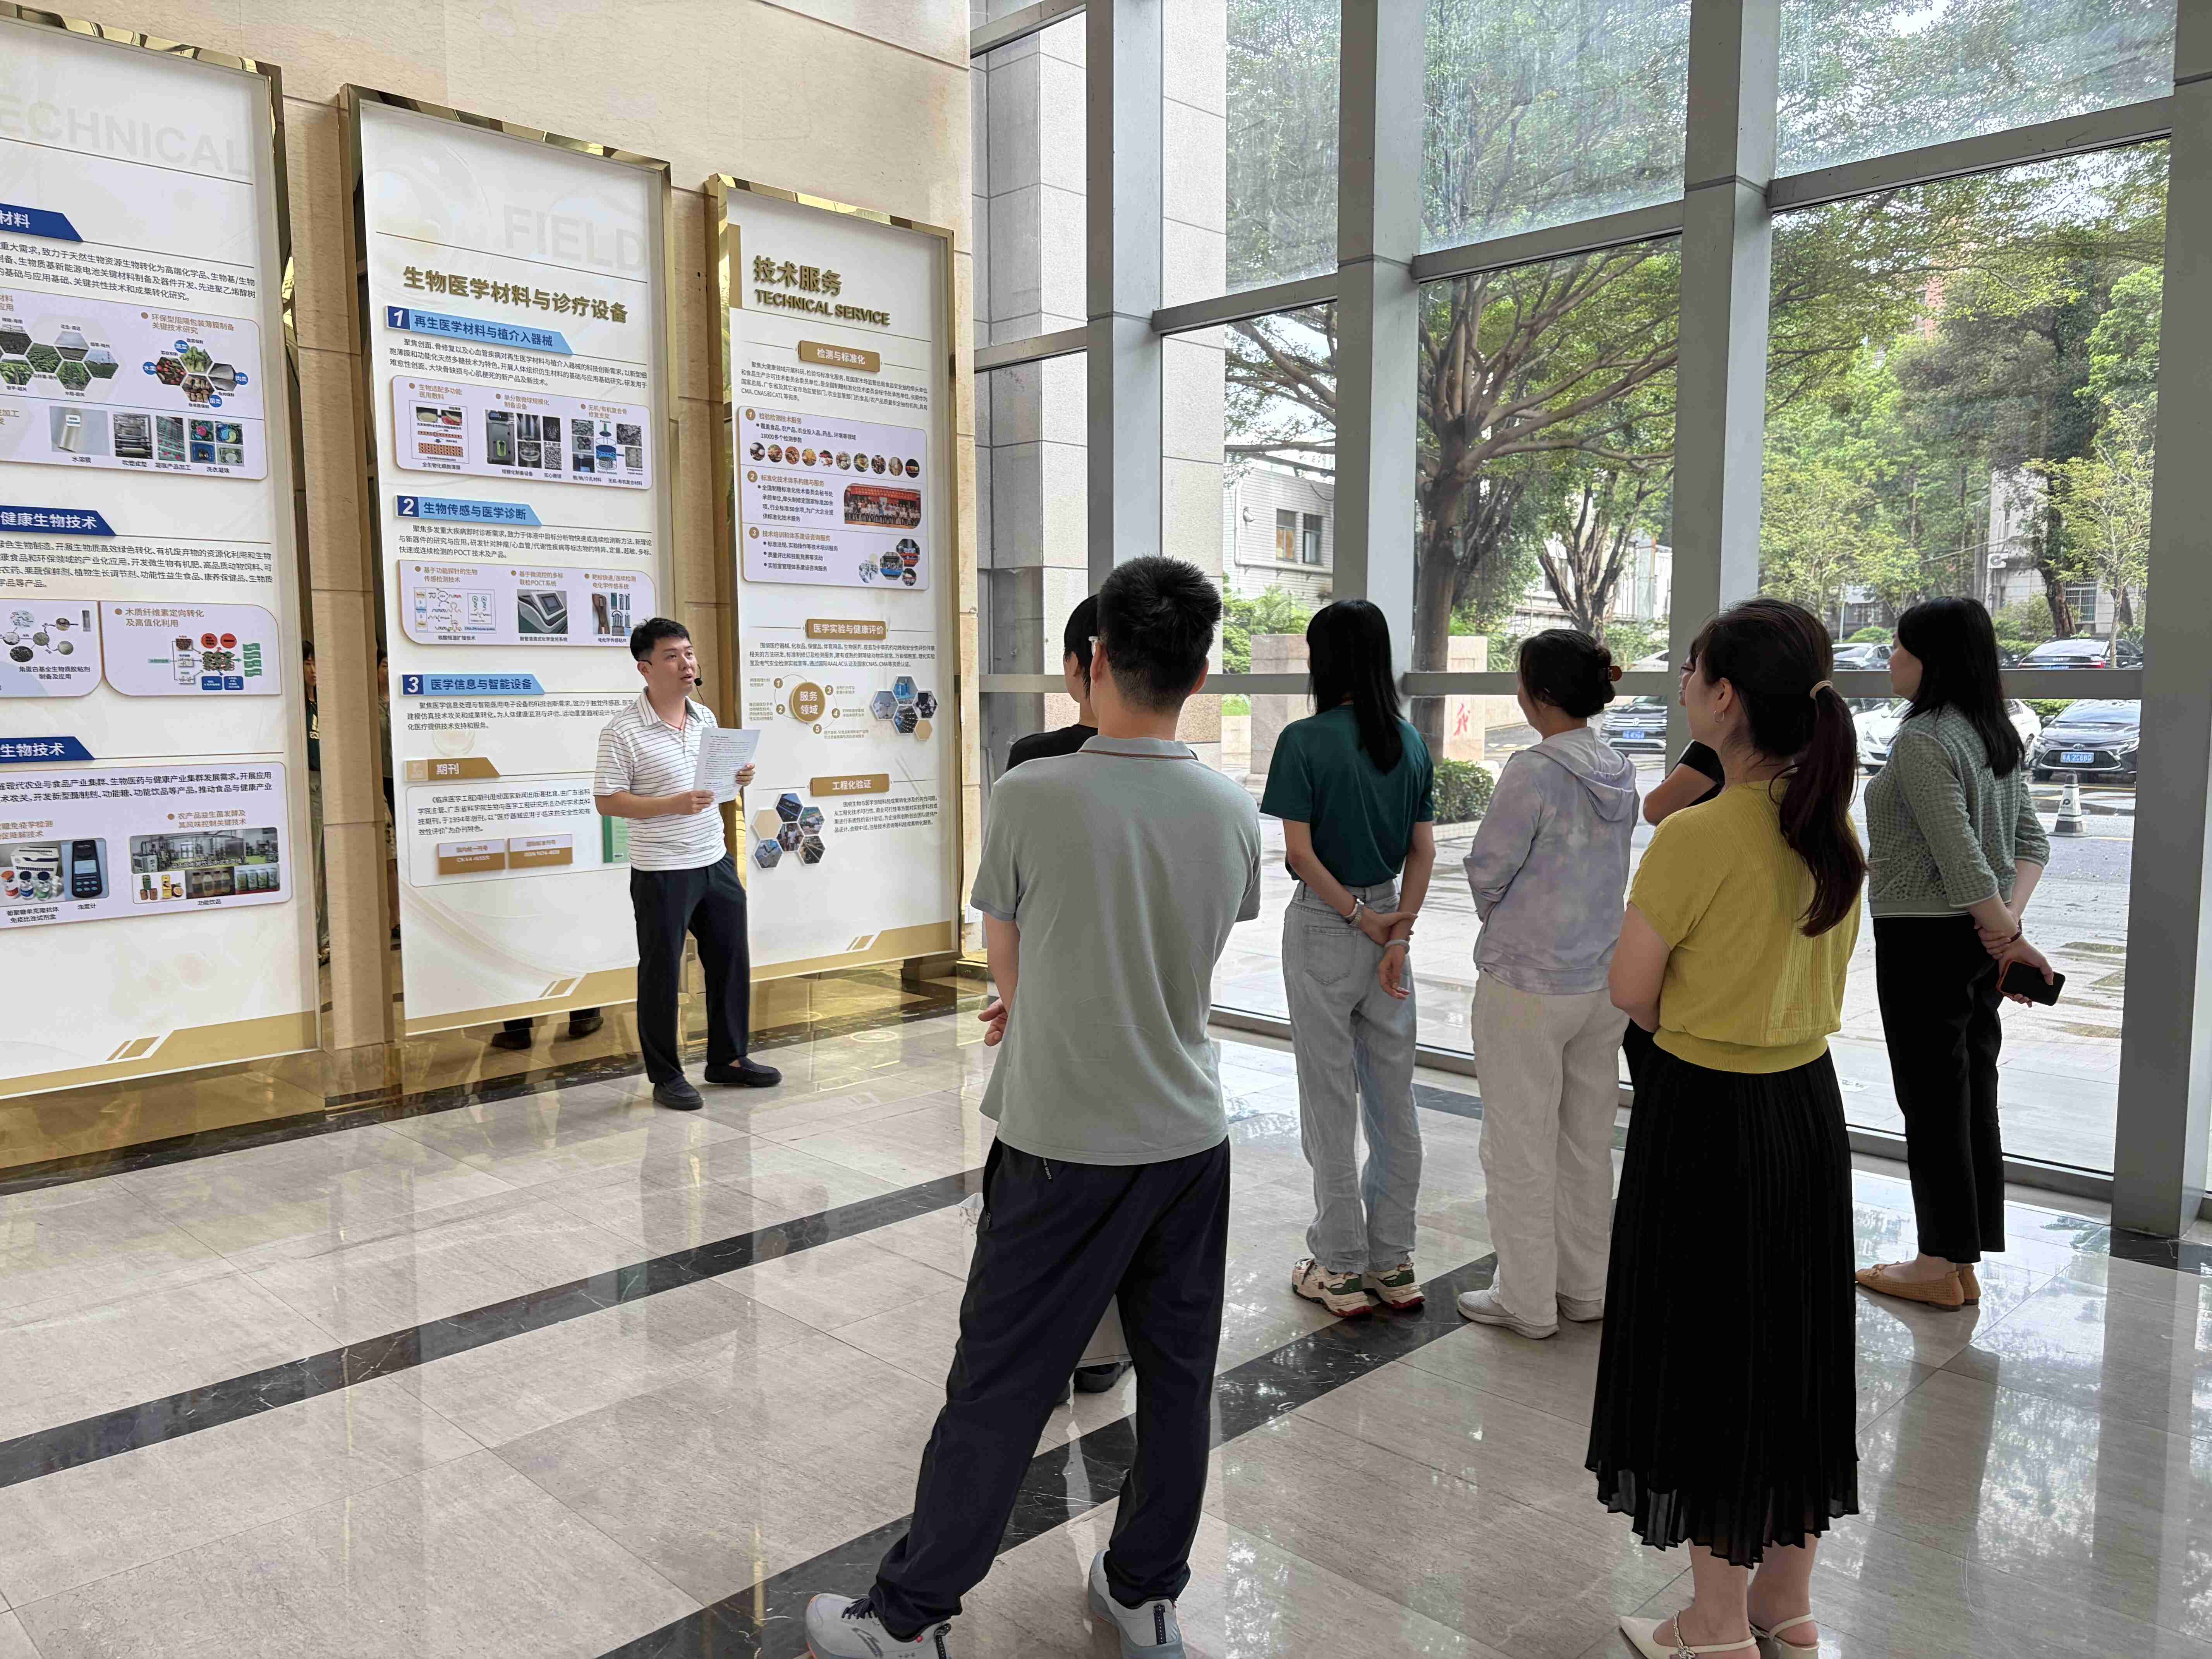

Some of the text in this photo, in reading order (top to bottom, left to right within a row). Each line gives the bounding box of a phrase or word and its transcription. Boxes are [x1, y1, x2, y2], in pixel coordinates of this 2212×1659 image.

[503, 204, 647, 271] FIELD
[753, 255, 843, 296] 技术服务
[403, 266, 628, 323] 生物医学材料与诊疗设备
[755, 289, 891, 326] TECHNICAL SERVICE
[393, 310, 403, 326] 1
[414, 315, 553, 347] 再生医学材料与植介入器械
[817, 347, 866, 365] 检测与标准化
[402, 498, 415, 515] 2
[424, 502, 526, 520] 生物传感与医学诊断
[0, 511, 97, 529] 健康生物技术
[814, 623, 885, 634] 医学实验与健康评价
[407, 677, 419, 693] 3
[431, 678, 532, 690] 医学信息与智能设备
[800, 690, 818, 702] 服务
[800, 704, 818, 716] 领域
[0, 743, 65, 758] 生物技术
[832, 780, 872, 791] 工程化验证
